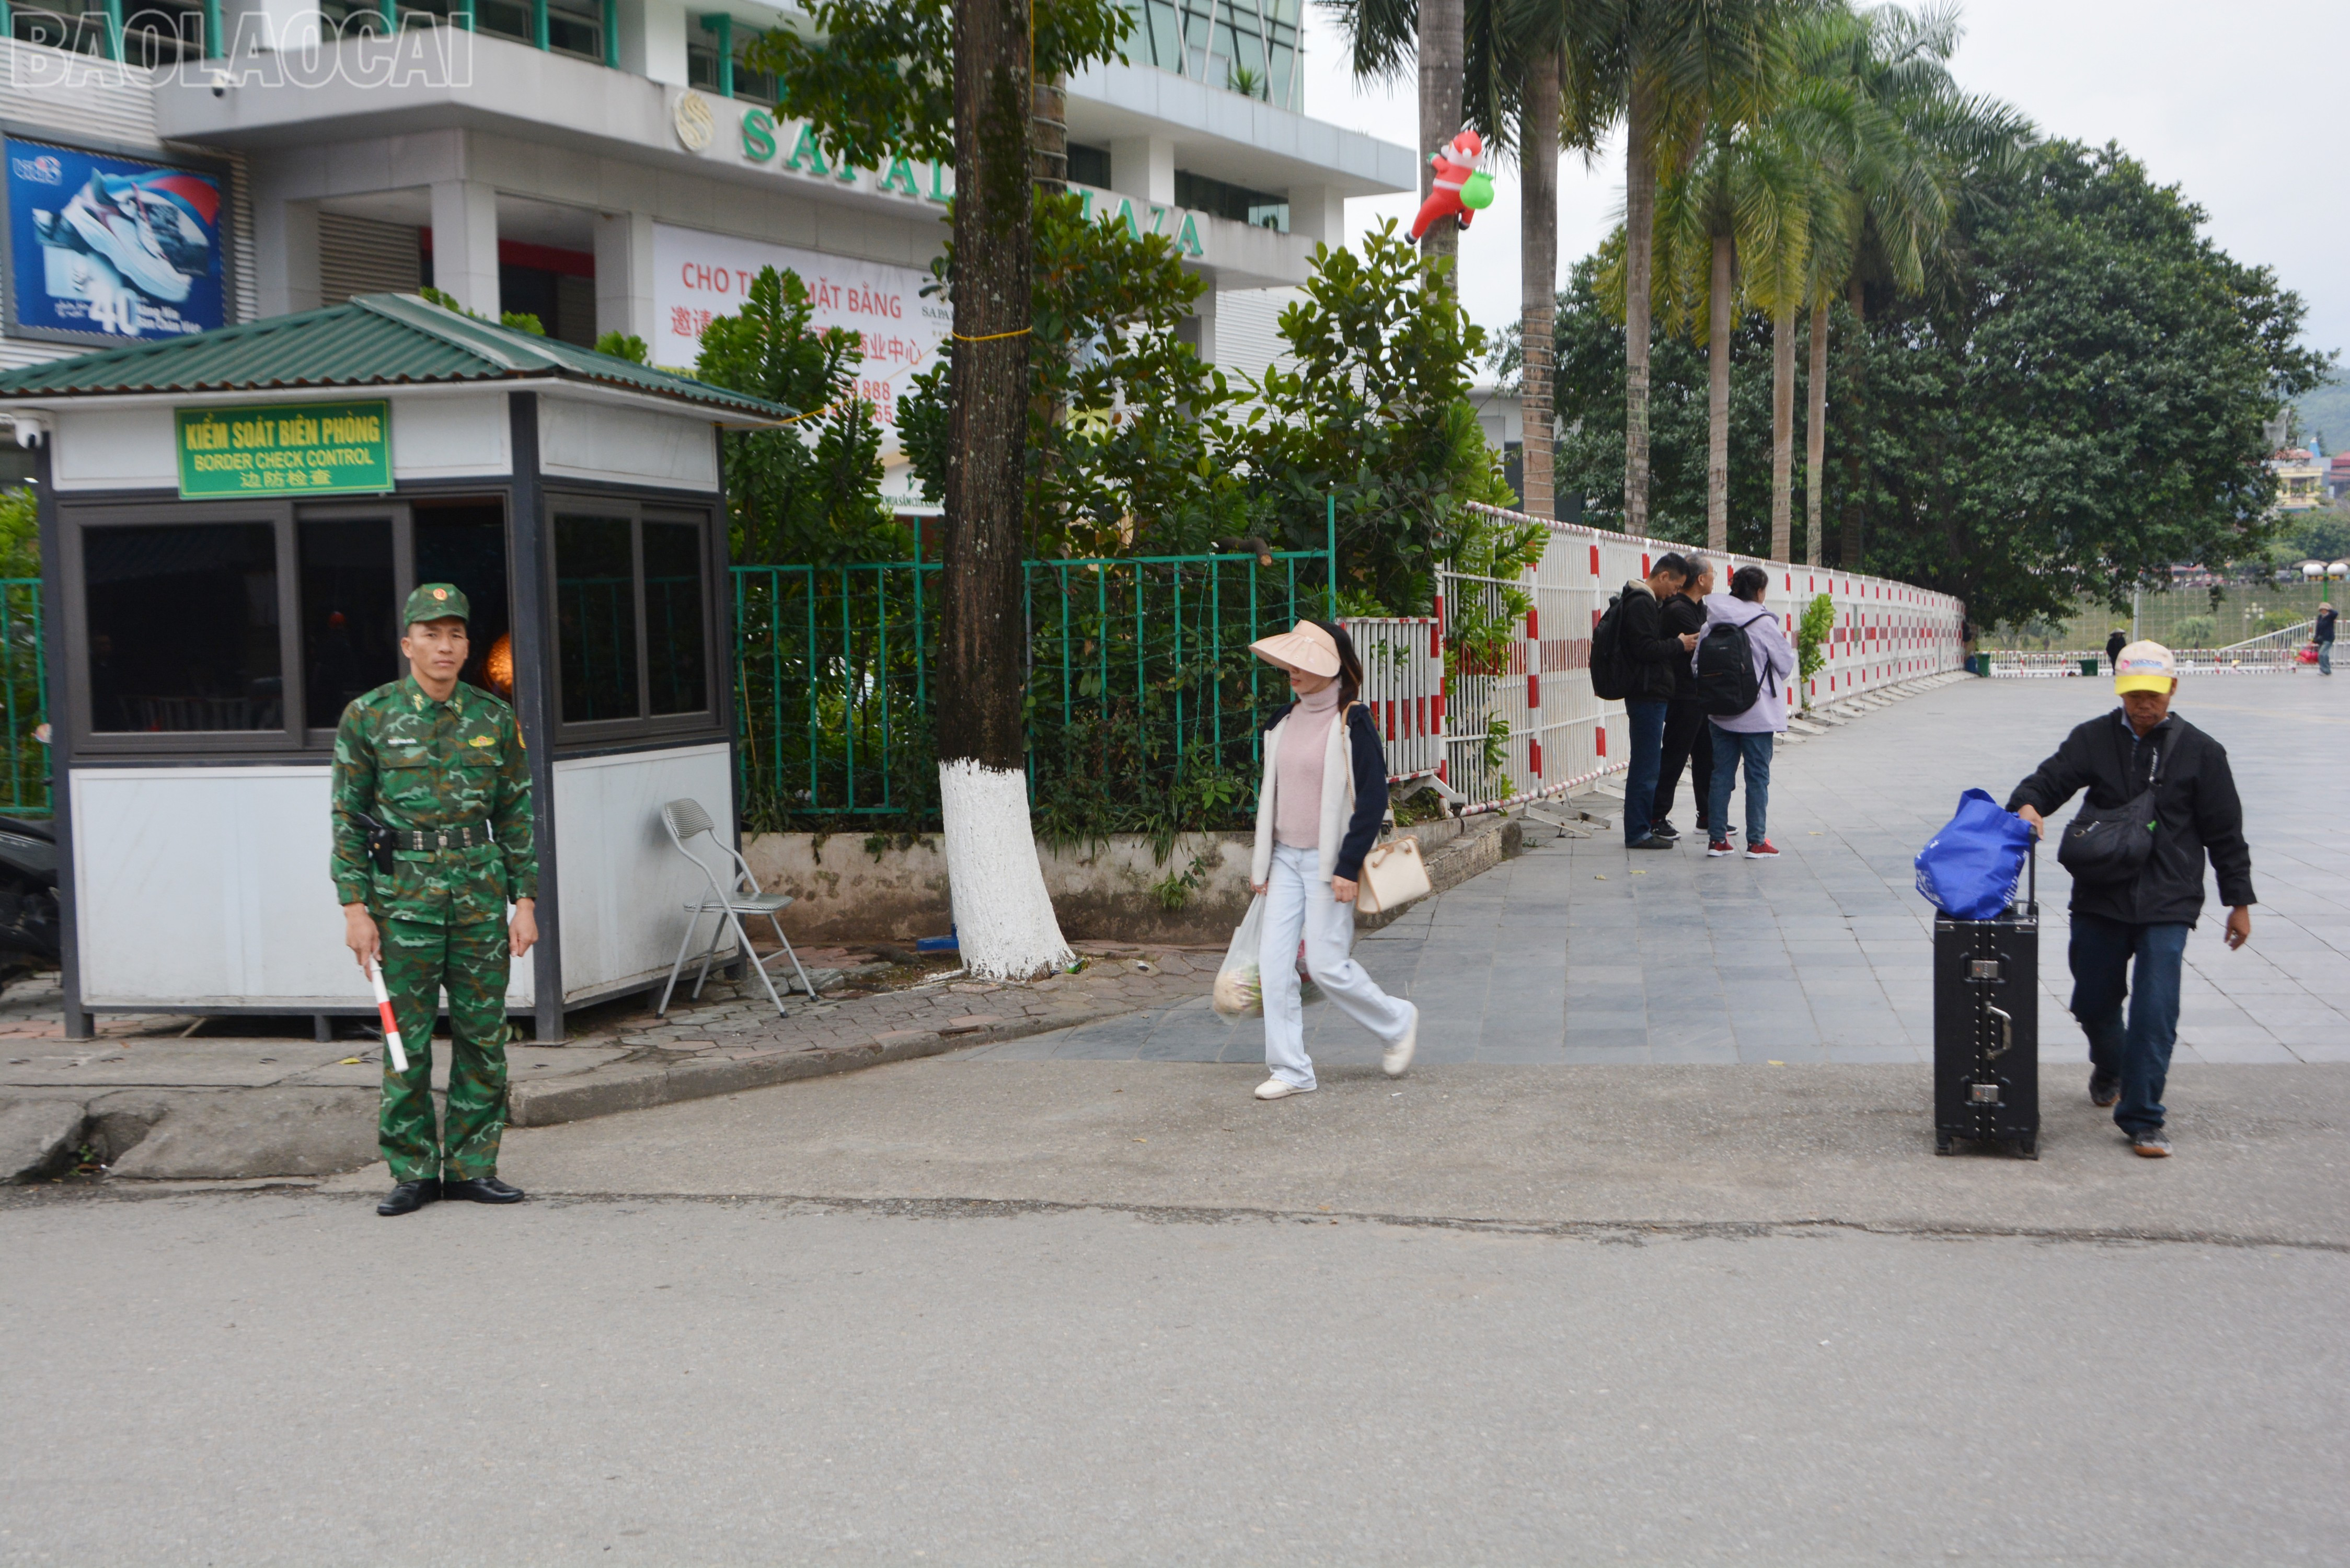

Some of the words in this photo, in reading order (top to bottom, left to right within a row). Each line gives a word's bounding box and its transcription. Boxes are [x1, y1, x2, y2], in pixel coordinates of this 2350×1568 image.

[682, 262, 730, 293] CHO
[848, 281, 902, 319] BẰNG
[921, 306, 954, 320] SAPA
[185, 412, 229, 451] KIỂM
[232, 415, 275, 449] SOÁT
[278, 413, 319, 447] BIÊN
[321, 410, 381, 445] PHÒNG
[193, 453, 254, 471] BORDER
[255, 451, 305, 470] CHECK
[306, 447, 375, 467] CONTROL
[239, 469, 333, 488] 边防检查
